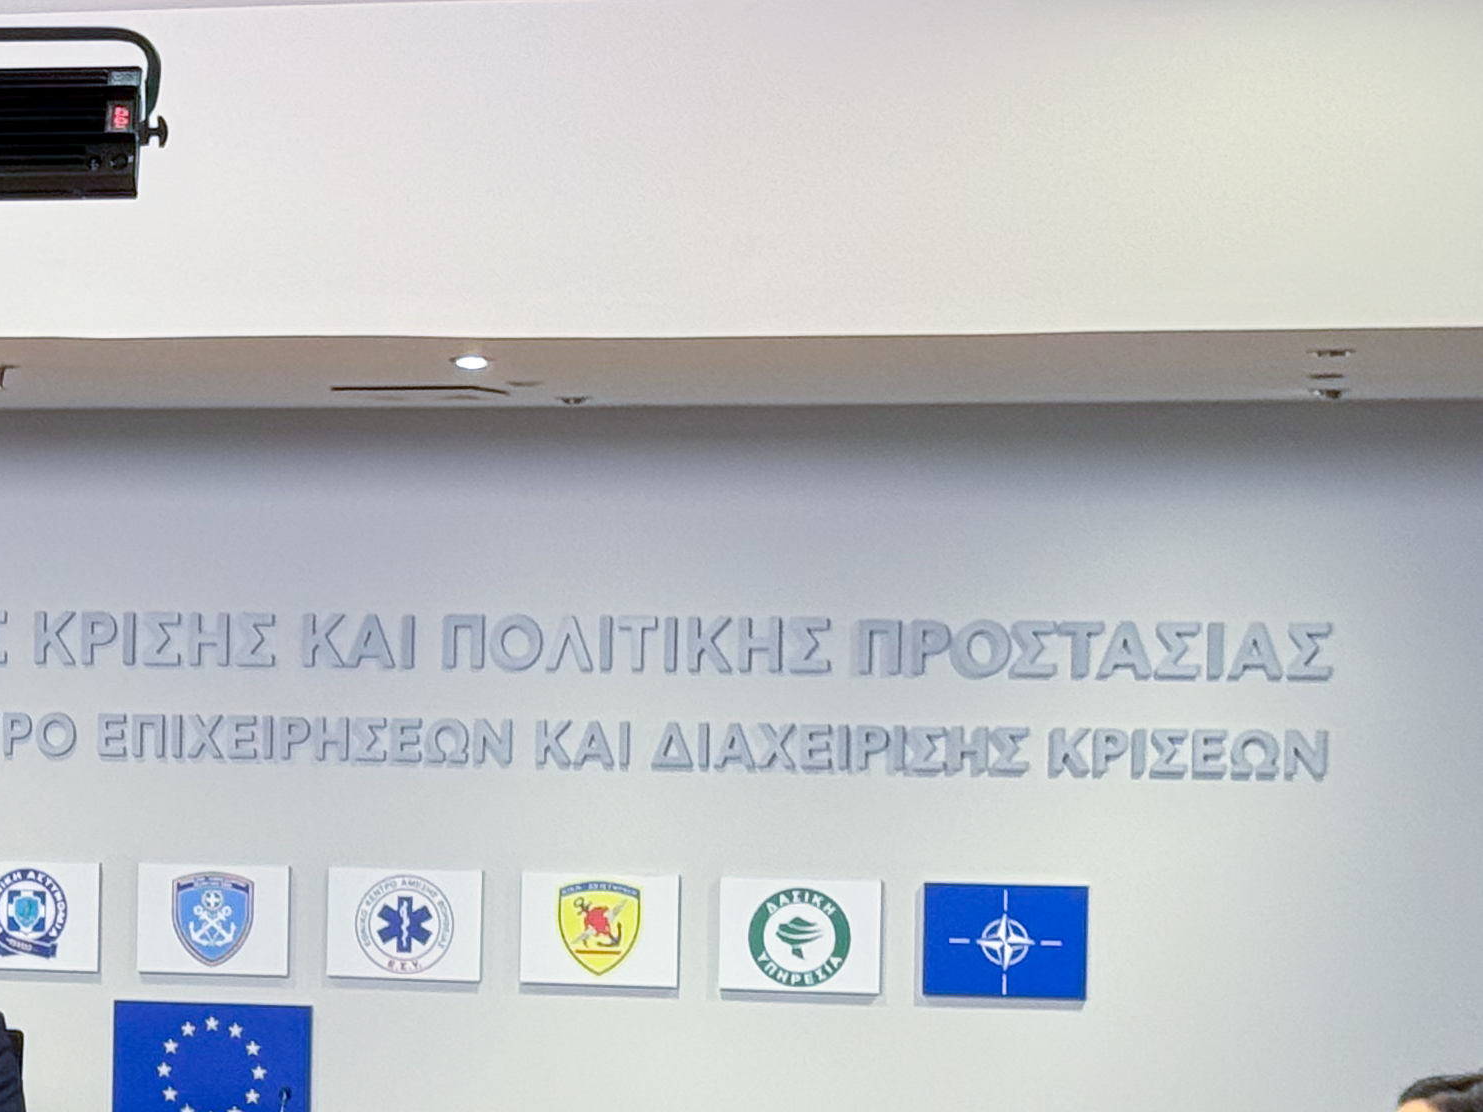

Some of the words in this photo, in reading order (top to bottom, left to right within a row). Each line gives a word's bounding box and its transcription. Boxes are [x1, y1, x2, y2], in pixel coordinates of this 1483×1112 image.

[33, 610, 276, 667] ΚΡΙΣΗΣ
[302, 613, 416, 669] ΚΑΙ
[442, 613, 832, 674] ΠΟΛΙΤΙΚΗΣ
[858, 618, 1333, 682] ΠΡΟΣΤΑΣΙΑΣ
[97, 713, 513, 769] ΕΠΙΧΕΙΡΗΣΕΩΝ
[535, 719, 631, 771] ΚΑΙ
[650, 721, 1030, 777] ΔΙΑΧΕΙΡΙΣΗΣ
[1047, 727, 1330, 781] ΚΡΙΣΕΩΝ
[766, 890, 837, 916] ΔΑΣΙΚΗ
[757, 951, 843, 985] ΥΠΗΡΕΣΙΑ
